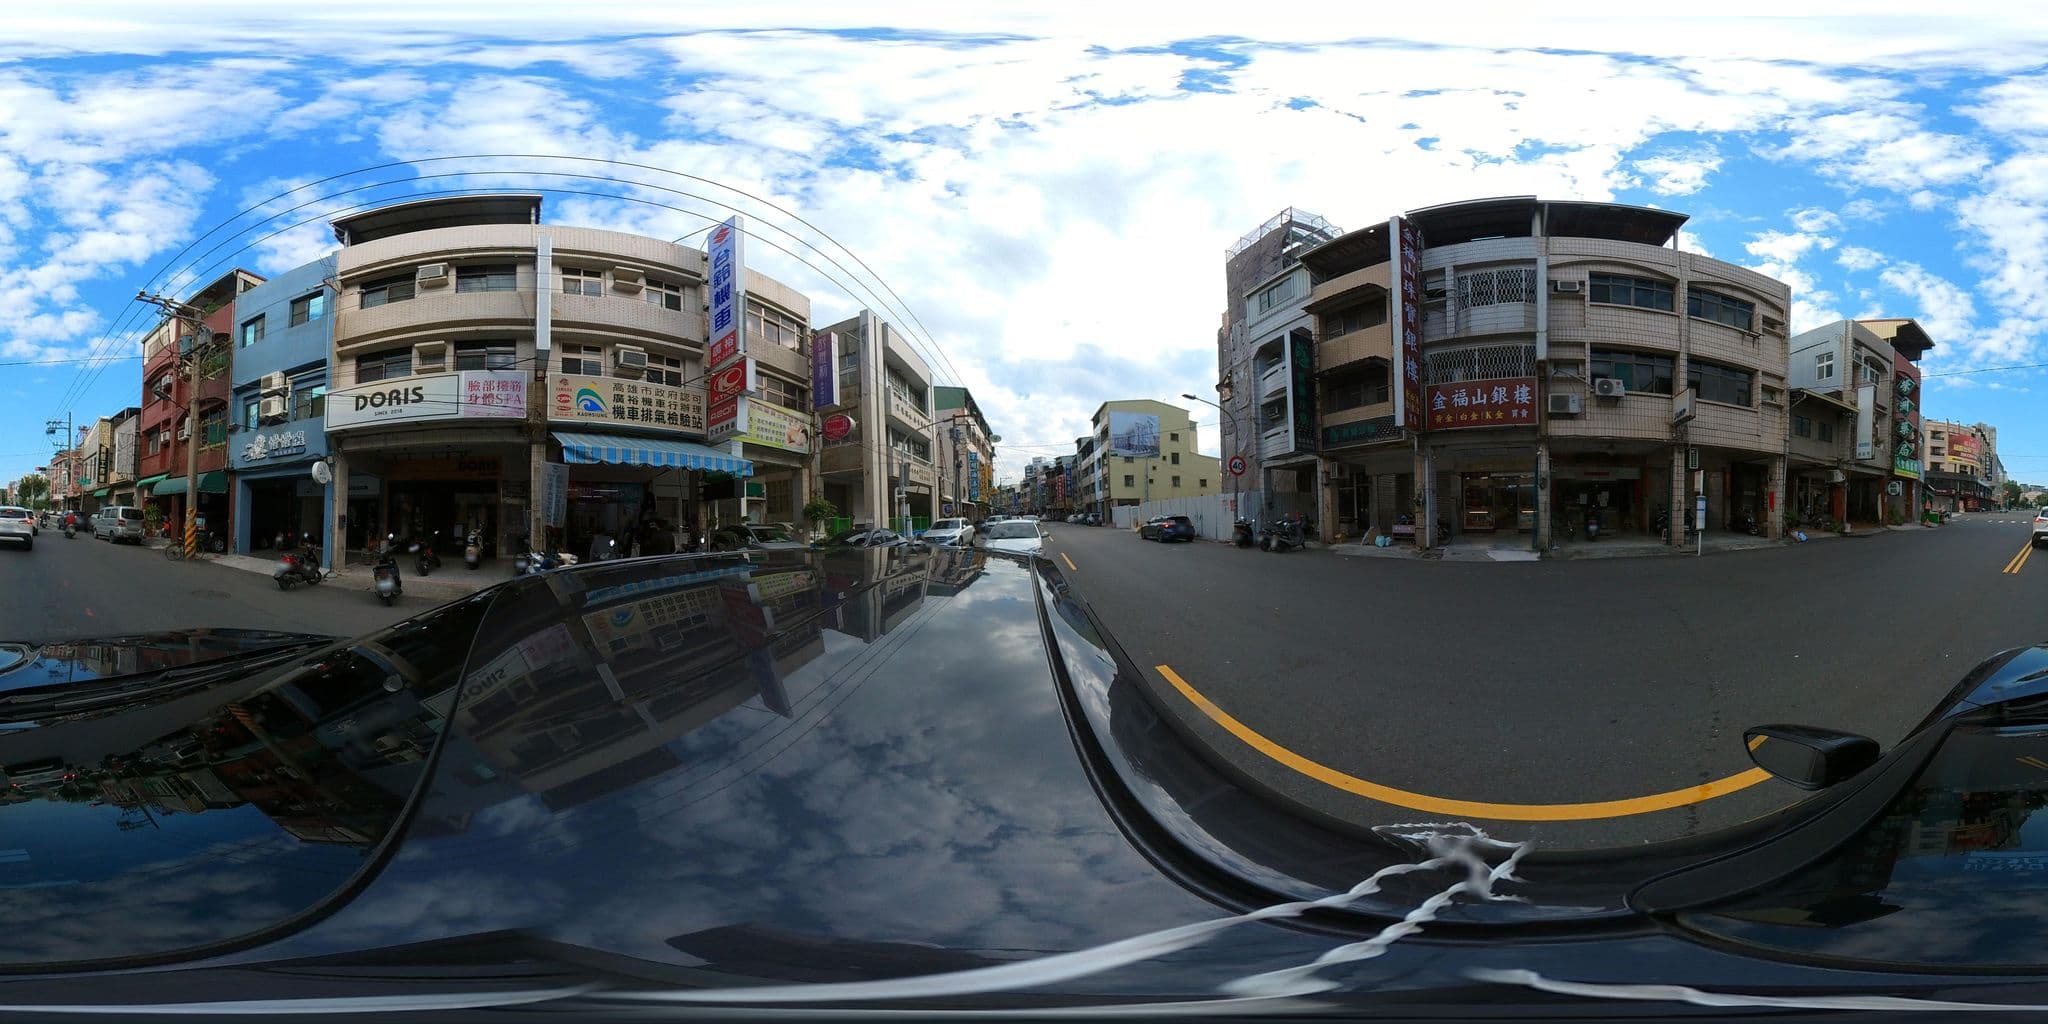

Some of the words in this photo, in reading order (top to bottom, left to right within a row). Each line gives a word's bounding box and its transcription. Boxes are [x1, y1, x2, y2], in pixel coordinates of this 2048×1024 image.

[714, 247, 731, 334] 台鈴機車
[355, 386, 424, 412] DORIS
[1432, 384, 1532, 411] 金福山銀樓
[612, 403, 704, 430] 機車排氣檢驗站
[1232, 461, 1244, 471] 40
